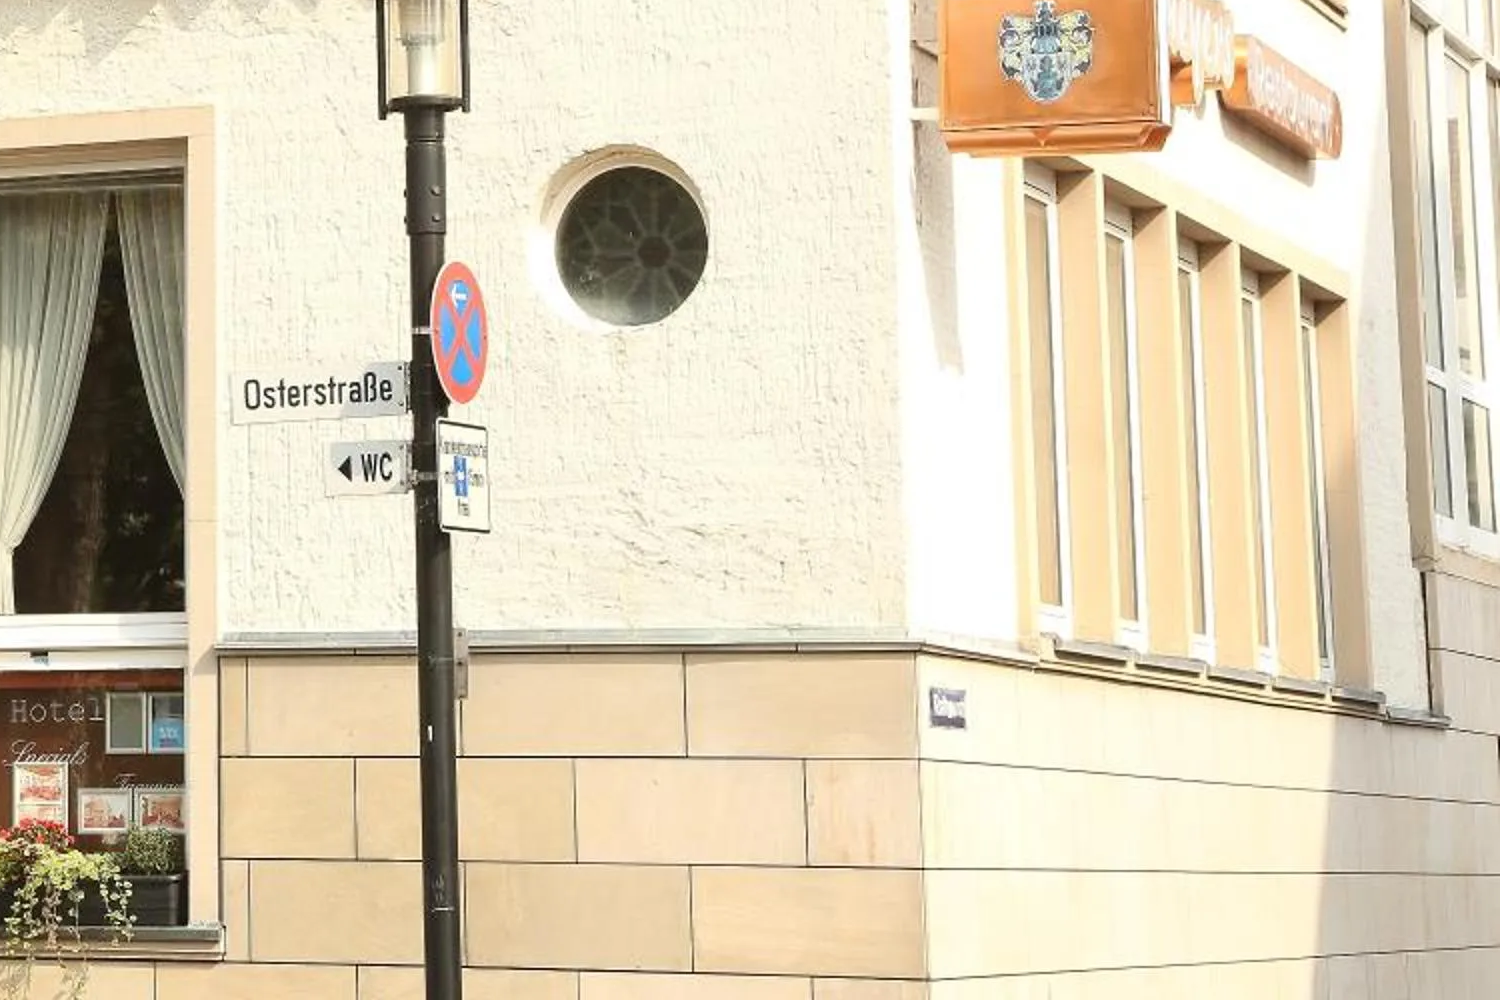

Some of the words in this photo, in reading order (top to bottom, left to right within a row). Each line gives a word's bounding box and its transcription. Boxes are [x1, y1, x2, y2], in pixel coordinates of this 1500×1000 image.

[244, 372, 393, 410] Osterstraße
[361, 453, 393, 482] WC
[9, 697, 104, 723] Hotel
